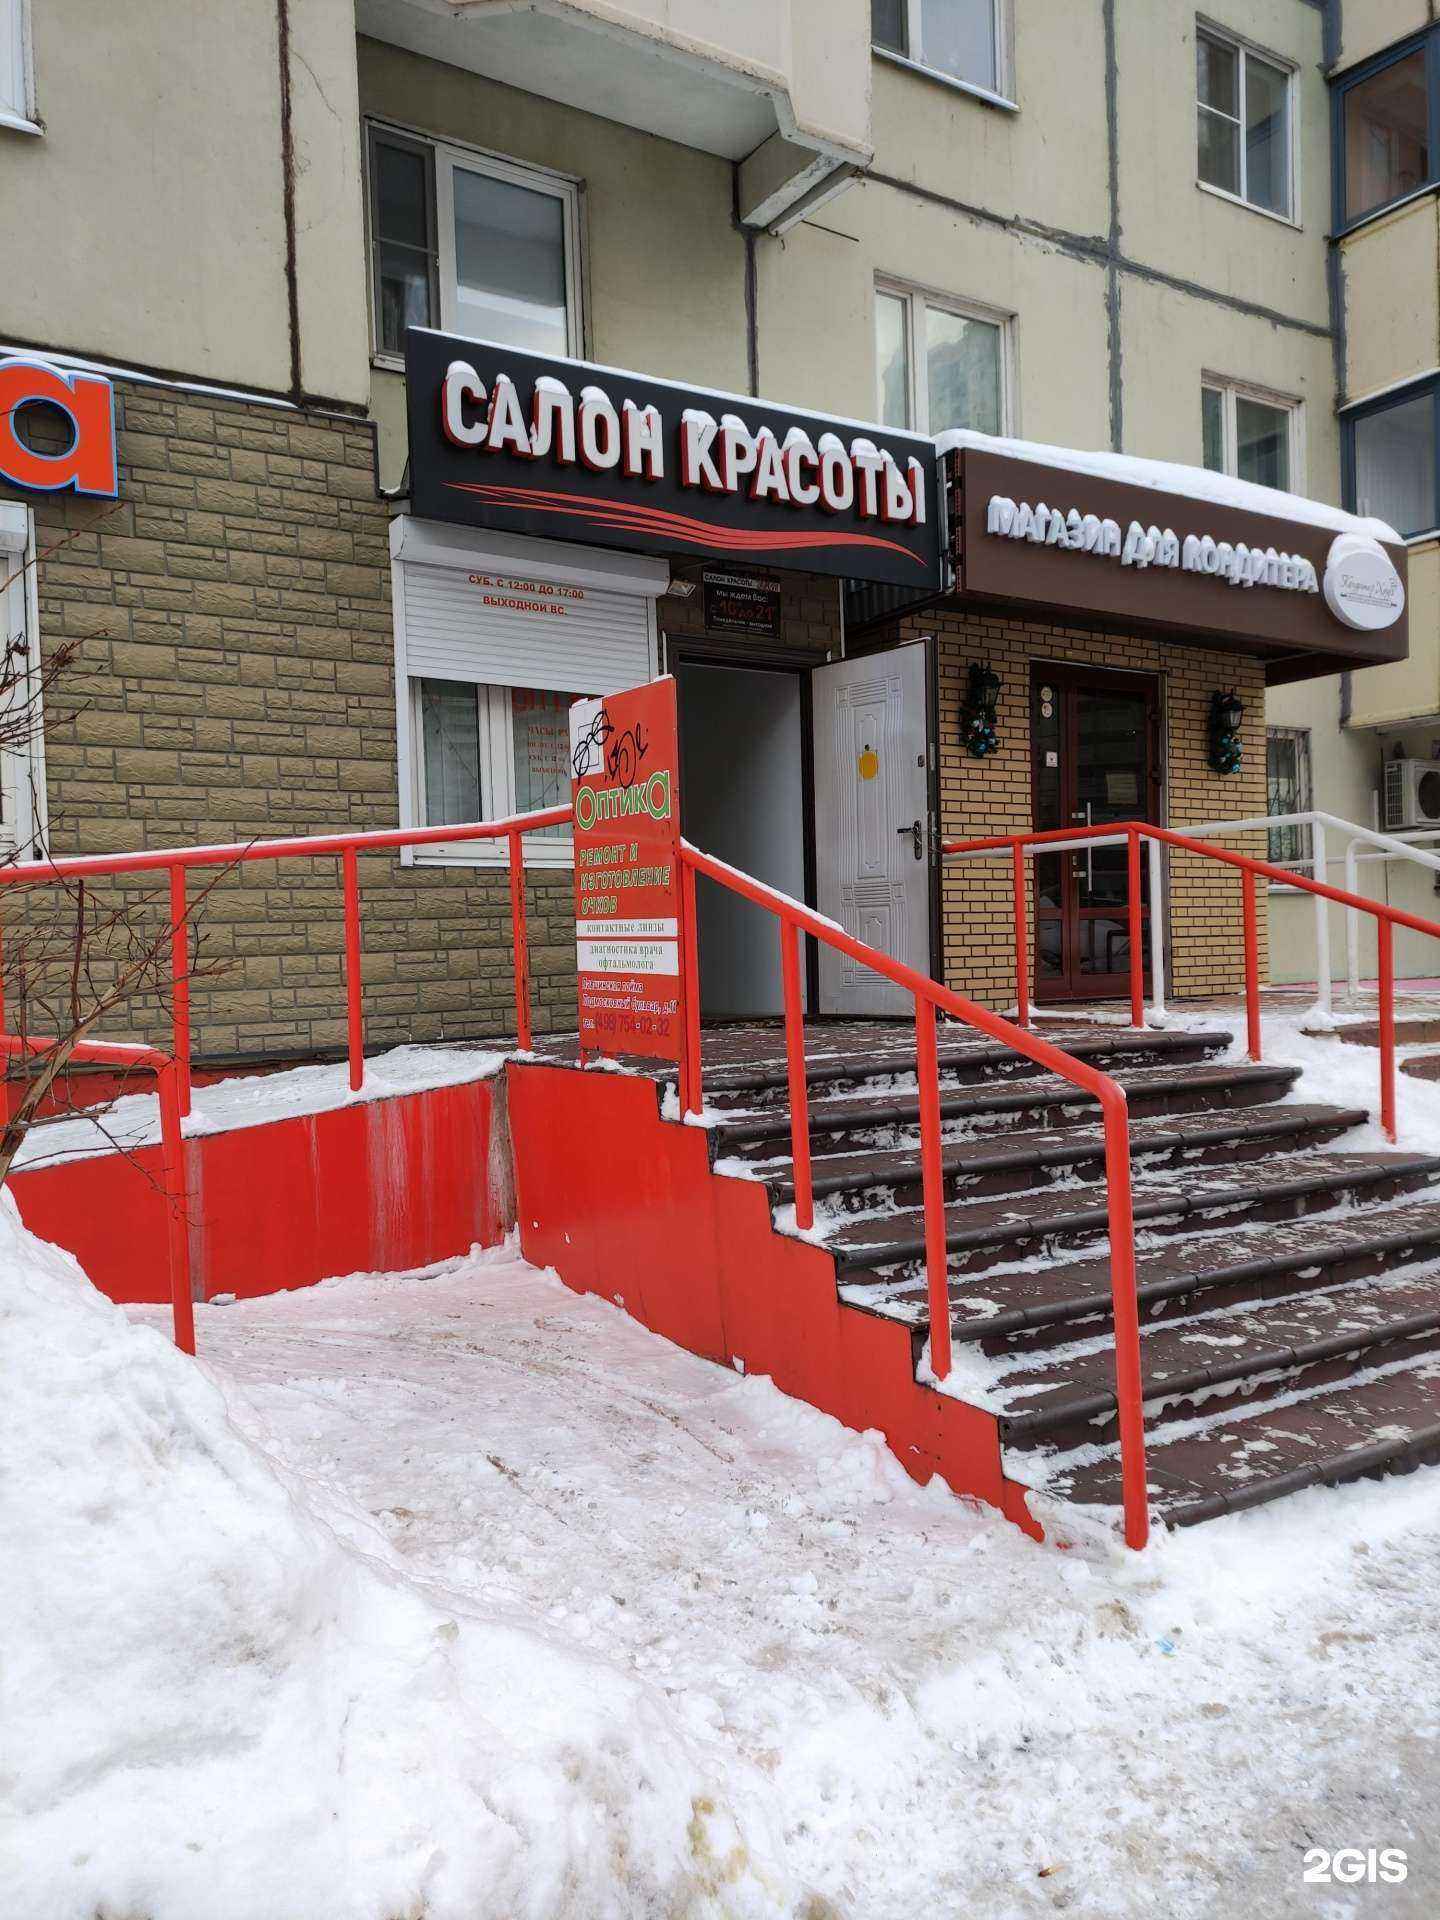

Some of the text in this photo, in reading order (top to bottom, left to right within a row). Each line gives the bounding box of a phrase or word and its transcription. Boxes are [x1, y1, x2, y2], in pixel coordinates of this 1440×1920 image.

[441, 360, 926, 526] САЛОН КРАСОТЫ
[987, 495, 1121, 557] МАГАЗИН
[1182, 534, 1319, 594] КОНДИТЕРА
[468, 575, 584, 599] СУБ. С 12:00 ДО 17:00
[550, 605, 568, 615] ВС.
[579, 843, 639, 867] РЕМОНТ И
[580, 865, 671, 891] ИЗГОТОВЛЕНИЕ
[581, 895, 618, 915] ОЧКОВ
[586, 923, 665, 933] контактные линзы
[590, 944, 663, 958] диагностика врача
[598, 957, 654, 971] офтальмолога
